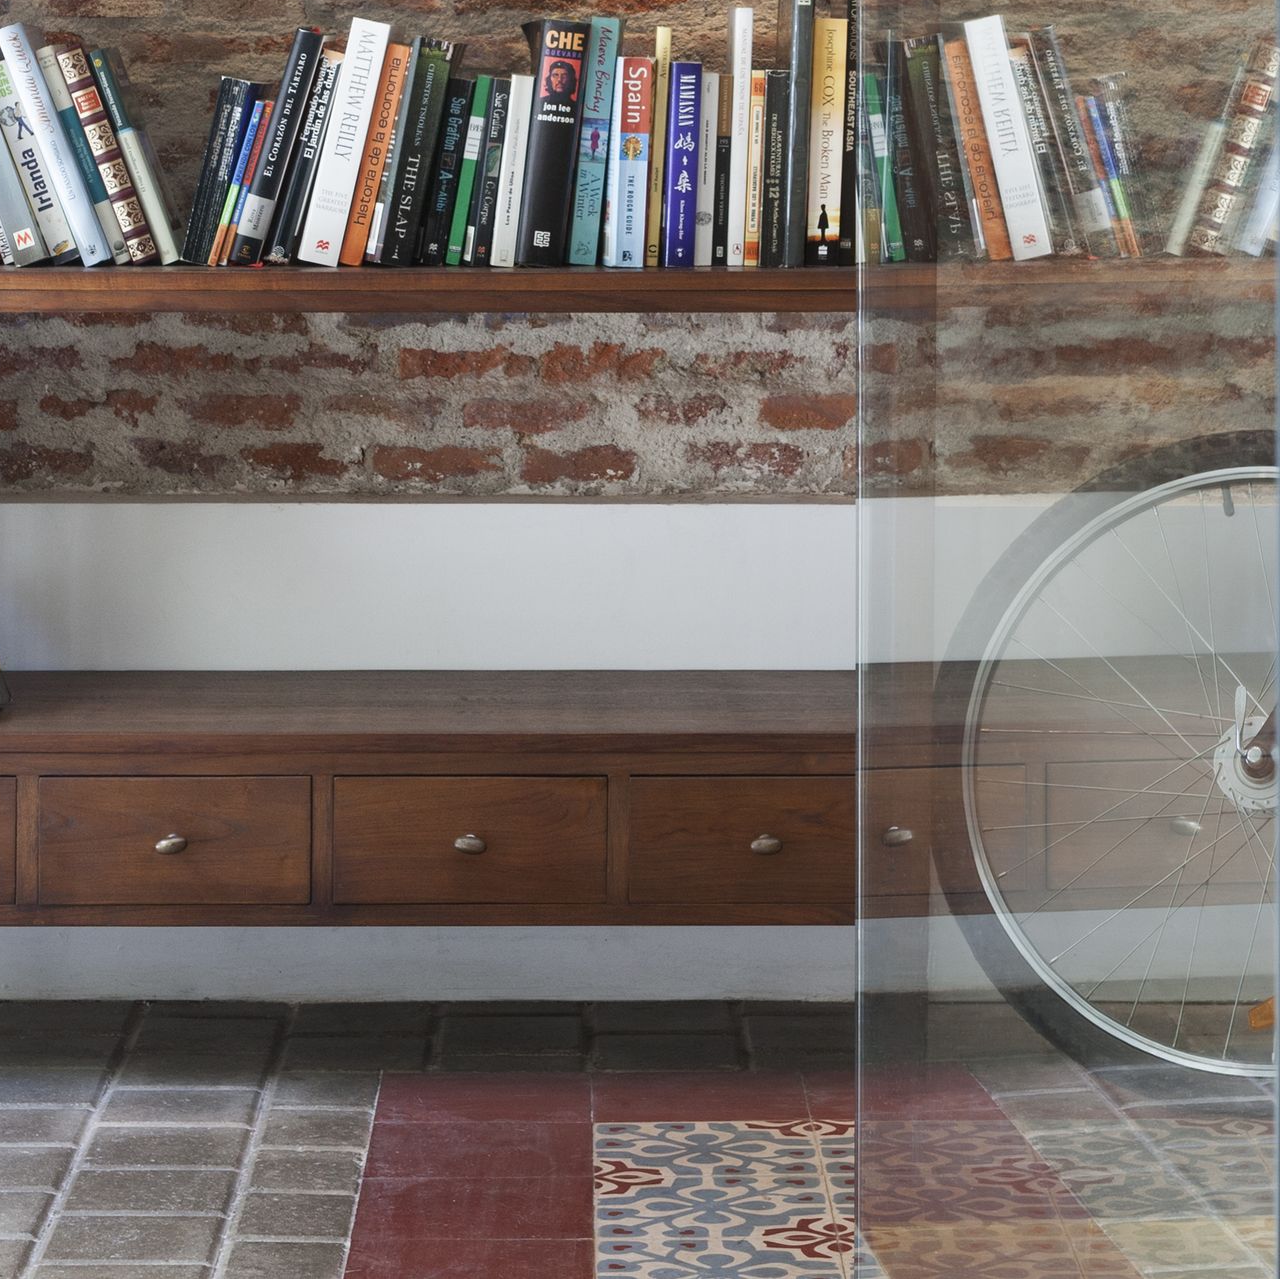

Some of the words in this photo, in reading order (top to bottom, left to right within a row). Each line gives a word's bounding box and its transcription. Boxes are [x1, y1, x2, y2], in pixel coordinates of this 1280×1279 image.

[7, 28, 31, 74] Quick
[545, 29, 584, 52] CHE
[596, 26, 613, 66] Maeve
[824, 28, 836, 71] Josephine
[287, 51, 306, 95] TÁRTARO
[345, 29, 376, 112] MATTHEW
[422, 62, 435, 105] CHRISTOS
[24, 73, 53, 135] Amanda
[284, 96, 293, 115] DEL
[319, 89, 329, 104] las
[449, 96, 466, 115] Sue
[494, 92, 507, 108] Sue
[585, 69, 610, 113] Binchy
[623, 66, 647, 123] Spain
[677, 74, 696, 126] MAMASAN
[822, 75, 834, 106] COX
[845, 70, 856, 128] SOUTHEAST
[300, 93, 319, 141] Fernando
[314, 104, 326, 118] de
[536, 113, 574, 123] anderson
[543, 102, 557, 111] jon
[558, 103, 571, 112] lee
[822, 112, 831, 126] The
[224, 105, 243, 147] Michael
[307, 118, 322, 147] jardín
[334, 111, 357, 162] REILLY
[371, 129, 385, 143] la
[443, 116, 462, 151] Grafton
[489, 108, 505, 138] Grafton
[268, 116, 286, 162] CORAZÓN
[303, 146, 314, 158] El
[820, 129, 833, 169] Broken
[845, 129, 854, 151] ASIA
[263, 163, 274, 177] EL
[367, 145, 381, 166] de
[19, 147, 51, 213] Irlanda
[403, 152, 420, 191] THE
[438, 170, 453, 180] A
[579, 168, 588, 179] in
[590, 173, 600, 183] A
[819, 172, 830, 199] Man
[354, 166, 376, 225] historia
[574, 181, 589, 220] Winter
[586, 186, 600, 217] Week
[768, 186, 779, 198] 12
[394, 193, 411, 238] SLAP
